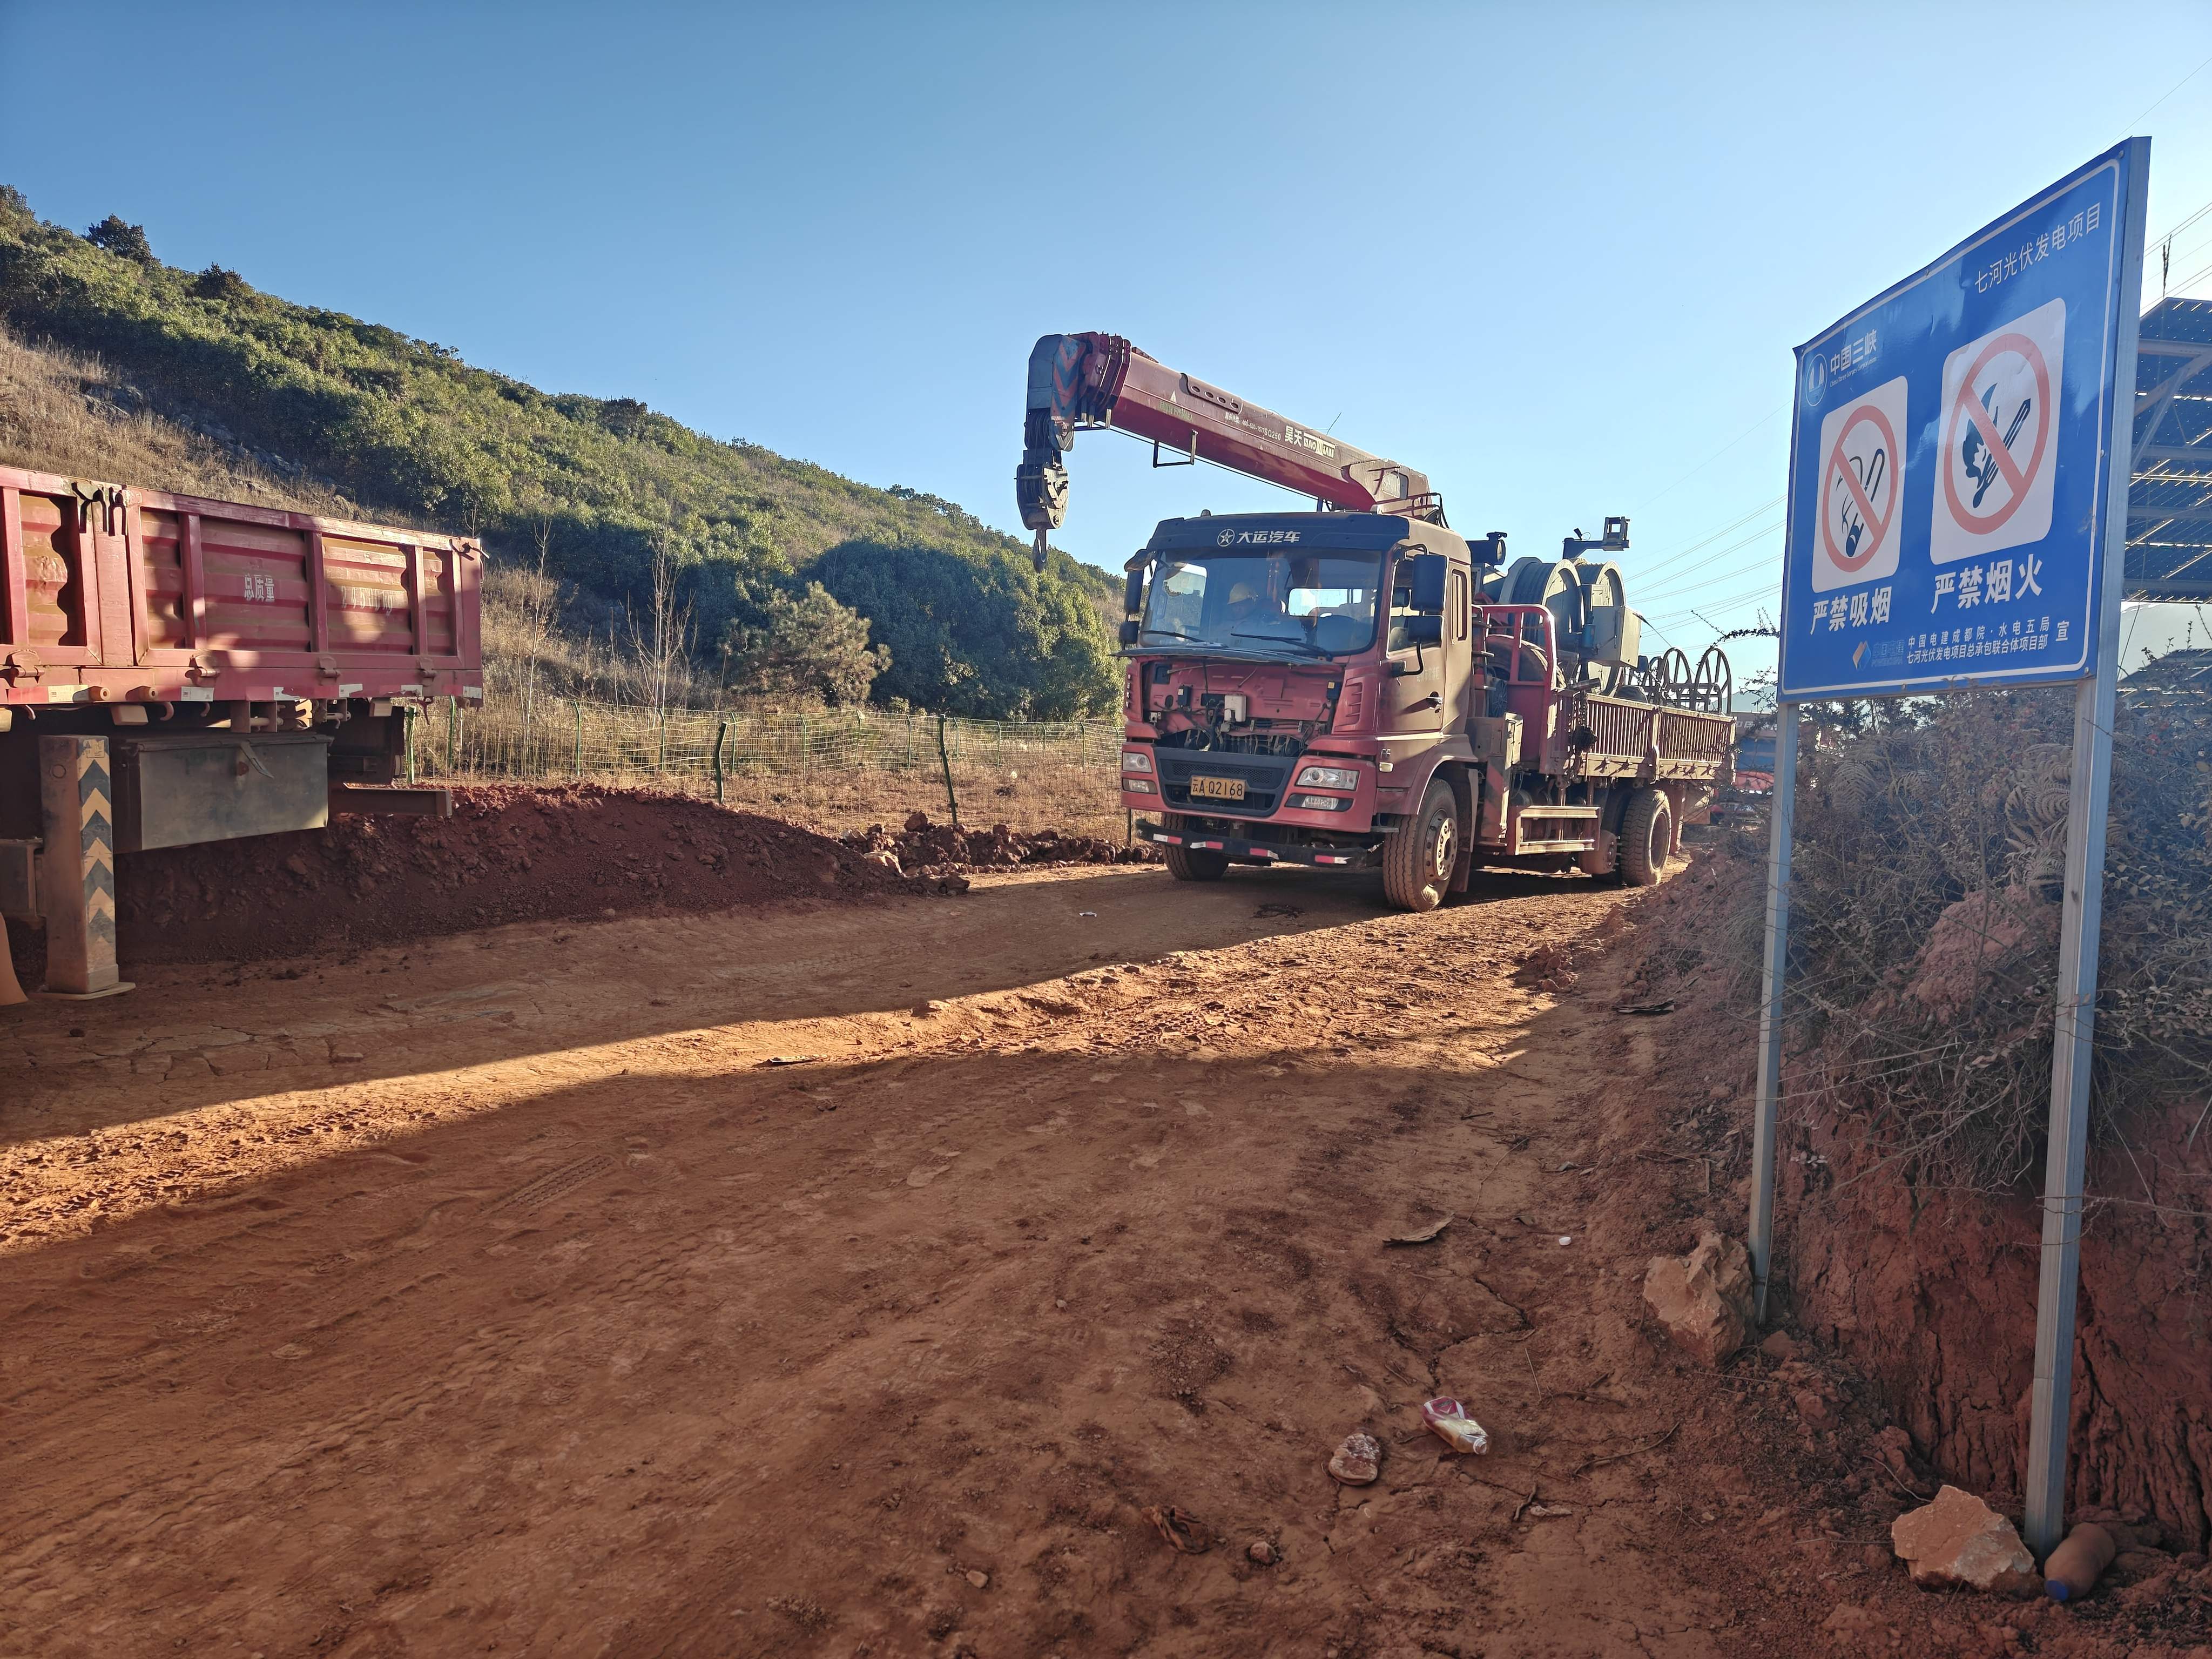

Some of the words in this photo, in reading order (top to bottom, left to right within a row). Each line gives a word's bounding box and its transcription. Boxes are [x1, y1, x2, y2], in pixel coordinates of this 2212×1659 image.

[1975, 203, 2100, 293] 七河光伏发电项目
[1830, 329, 1877, 375] 中国三峡
[1264, 428, 1282, 441] SQ250
[1285, 425, 1303, 447] 昊天
[1236, 531, 1301, 543] 大运汽车
[244, 573, 275, 602] 总质量
[1930, 554, 2044, 614] 严禁烟火
[1810, 586, 1892, 635] 严禁吸烟
[2055, 620, 2070, 642] 宣
[1906, 634, 2049, 664] 七河光伏发电项目总承包联合体项目部
